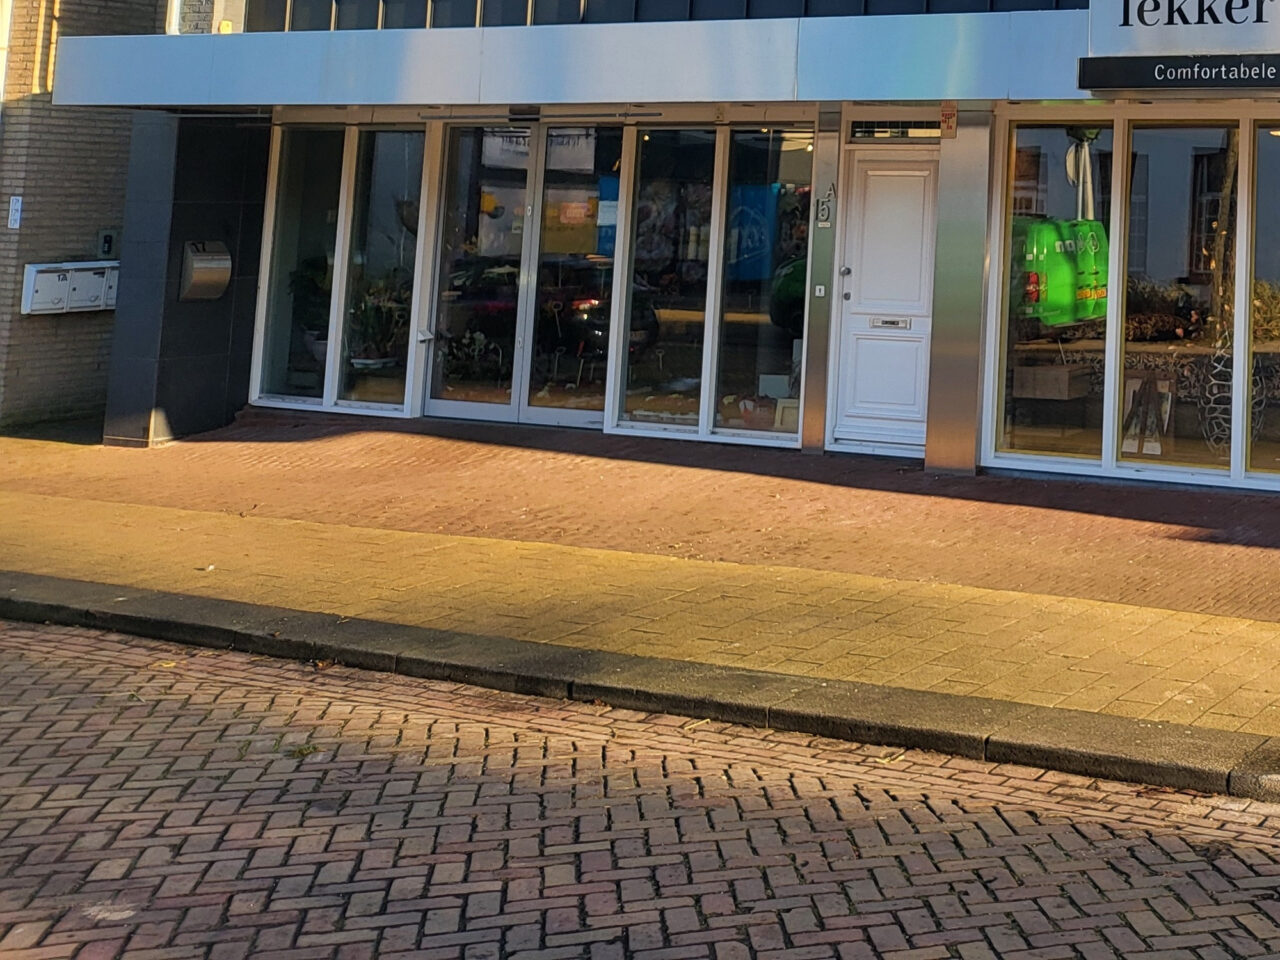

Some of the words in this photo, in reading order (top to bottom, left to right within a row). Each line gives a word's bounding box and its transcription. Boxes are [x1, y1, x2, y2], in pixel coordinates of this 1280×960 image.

[1154, 62, 1277, 80] Comfortabele
[825, 182, 837, 199] A
[815, 198, 831, 222] 15
